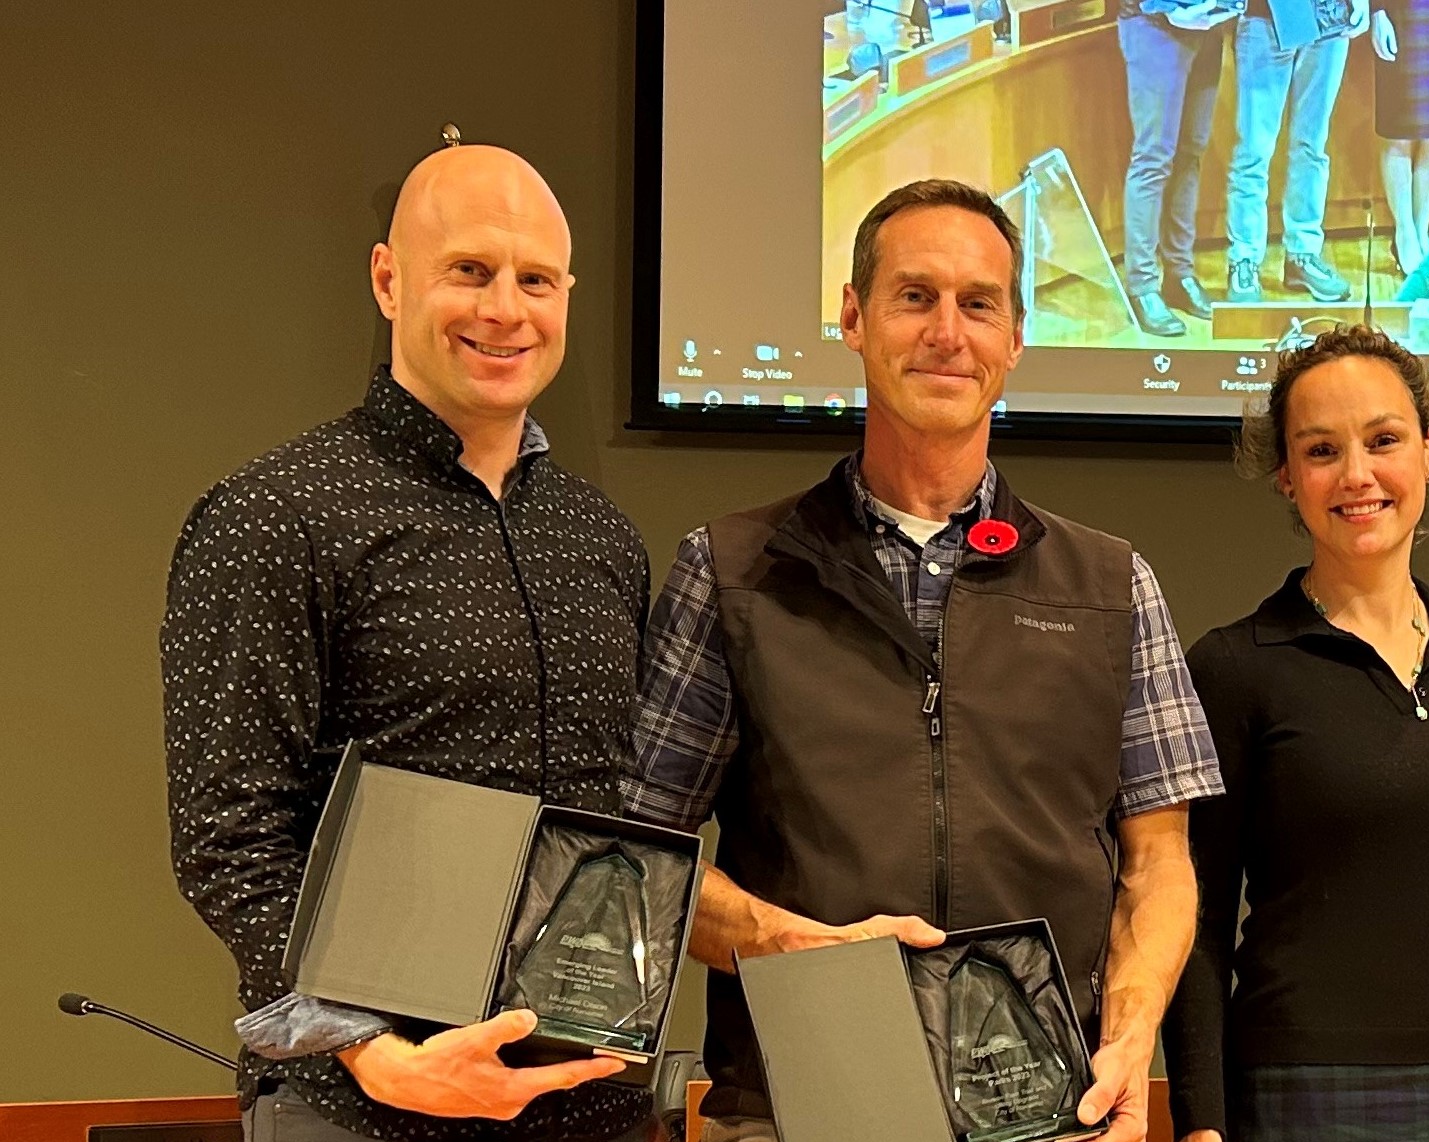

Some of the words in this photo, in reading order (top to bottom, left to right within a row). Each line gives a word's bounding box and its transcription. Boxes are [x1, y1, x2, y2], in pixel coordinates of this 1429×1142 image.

[1260, 358, 1267, 369] 3
[678, 366, 703, 377] Mute
[742, 367, 764, 381] Stop
[765, 368, 793, 380] Video
[1143, 378, 1180, 392] Security
[1014, 614, 1075, 631] patagonia
[556, 957, 592, 971] Emerging
[593, 964, 618, 975] Leader
